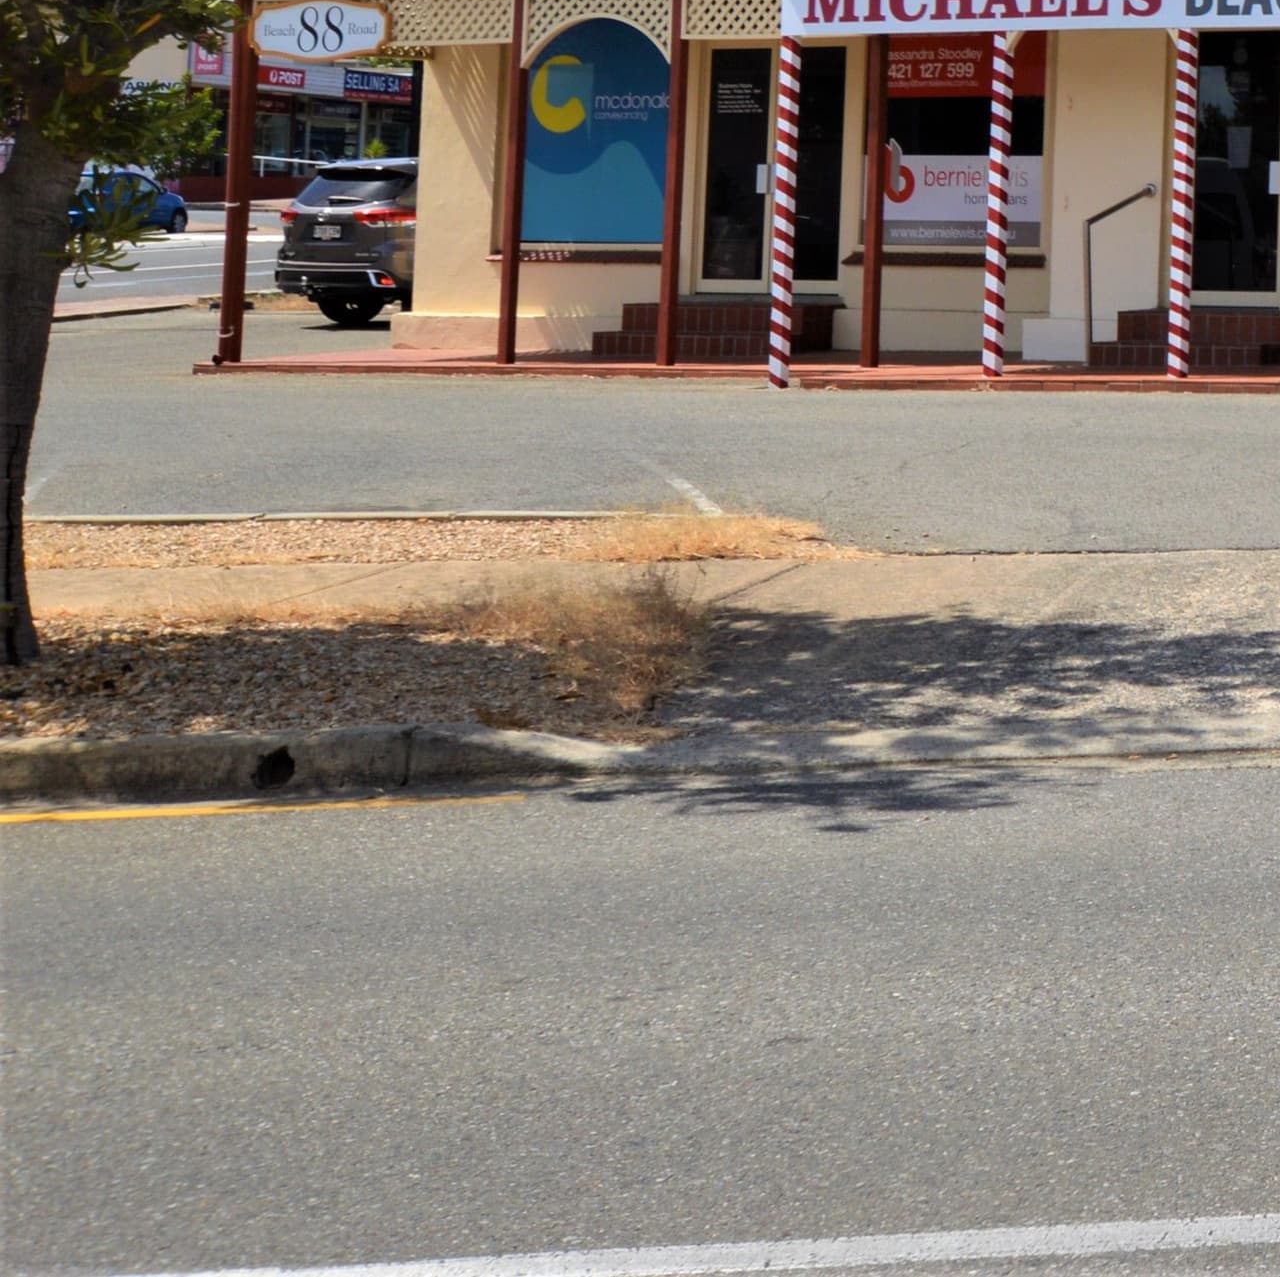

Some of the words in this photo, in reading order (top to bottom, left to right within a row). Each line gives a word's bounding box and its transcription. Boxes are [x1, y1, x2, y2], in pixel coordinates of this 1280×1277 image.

[263, 24, 296, 37] Beach
[296, 5, 345, 53] 88
[348, 22, 377, 35] Road
[888, 49, 935, 61] assandra
[938, 47, 983, 62] Stoodley
[278, 71, 304, 85] POST
[888, 64, 912, 79] 421
[919, 64, 943, 79] 127
[946, 62, 975, 78] 599
[346, 73, 387, 91] SELLING
